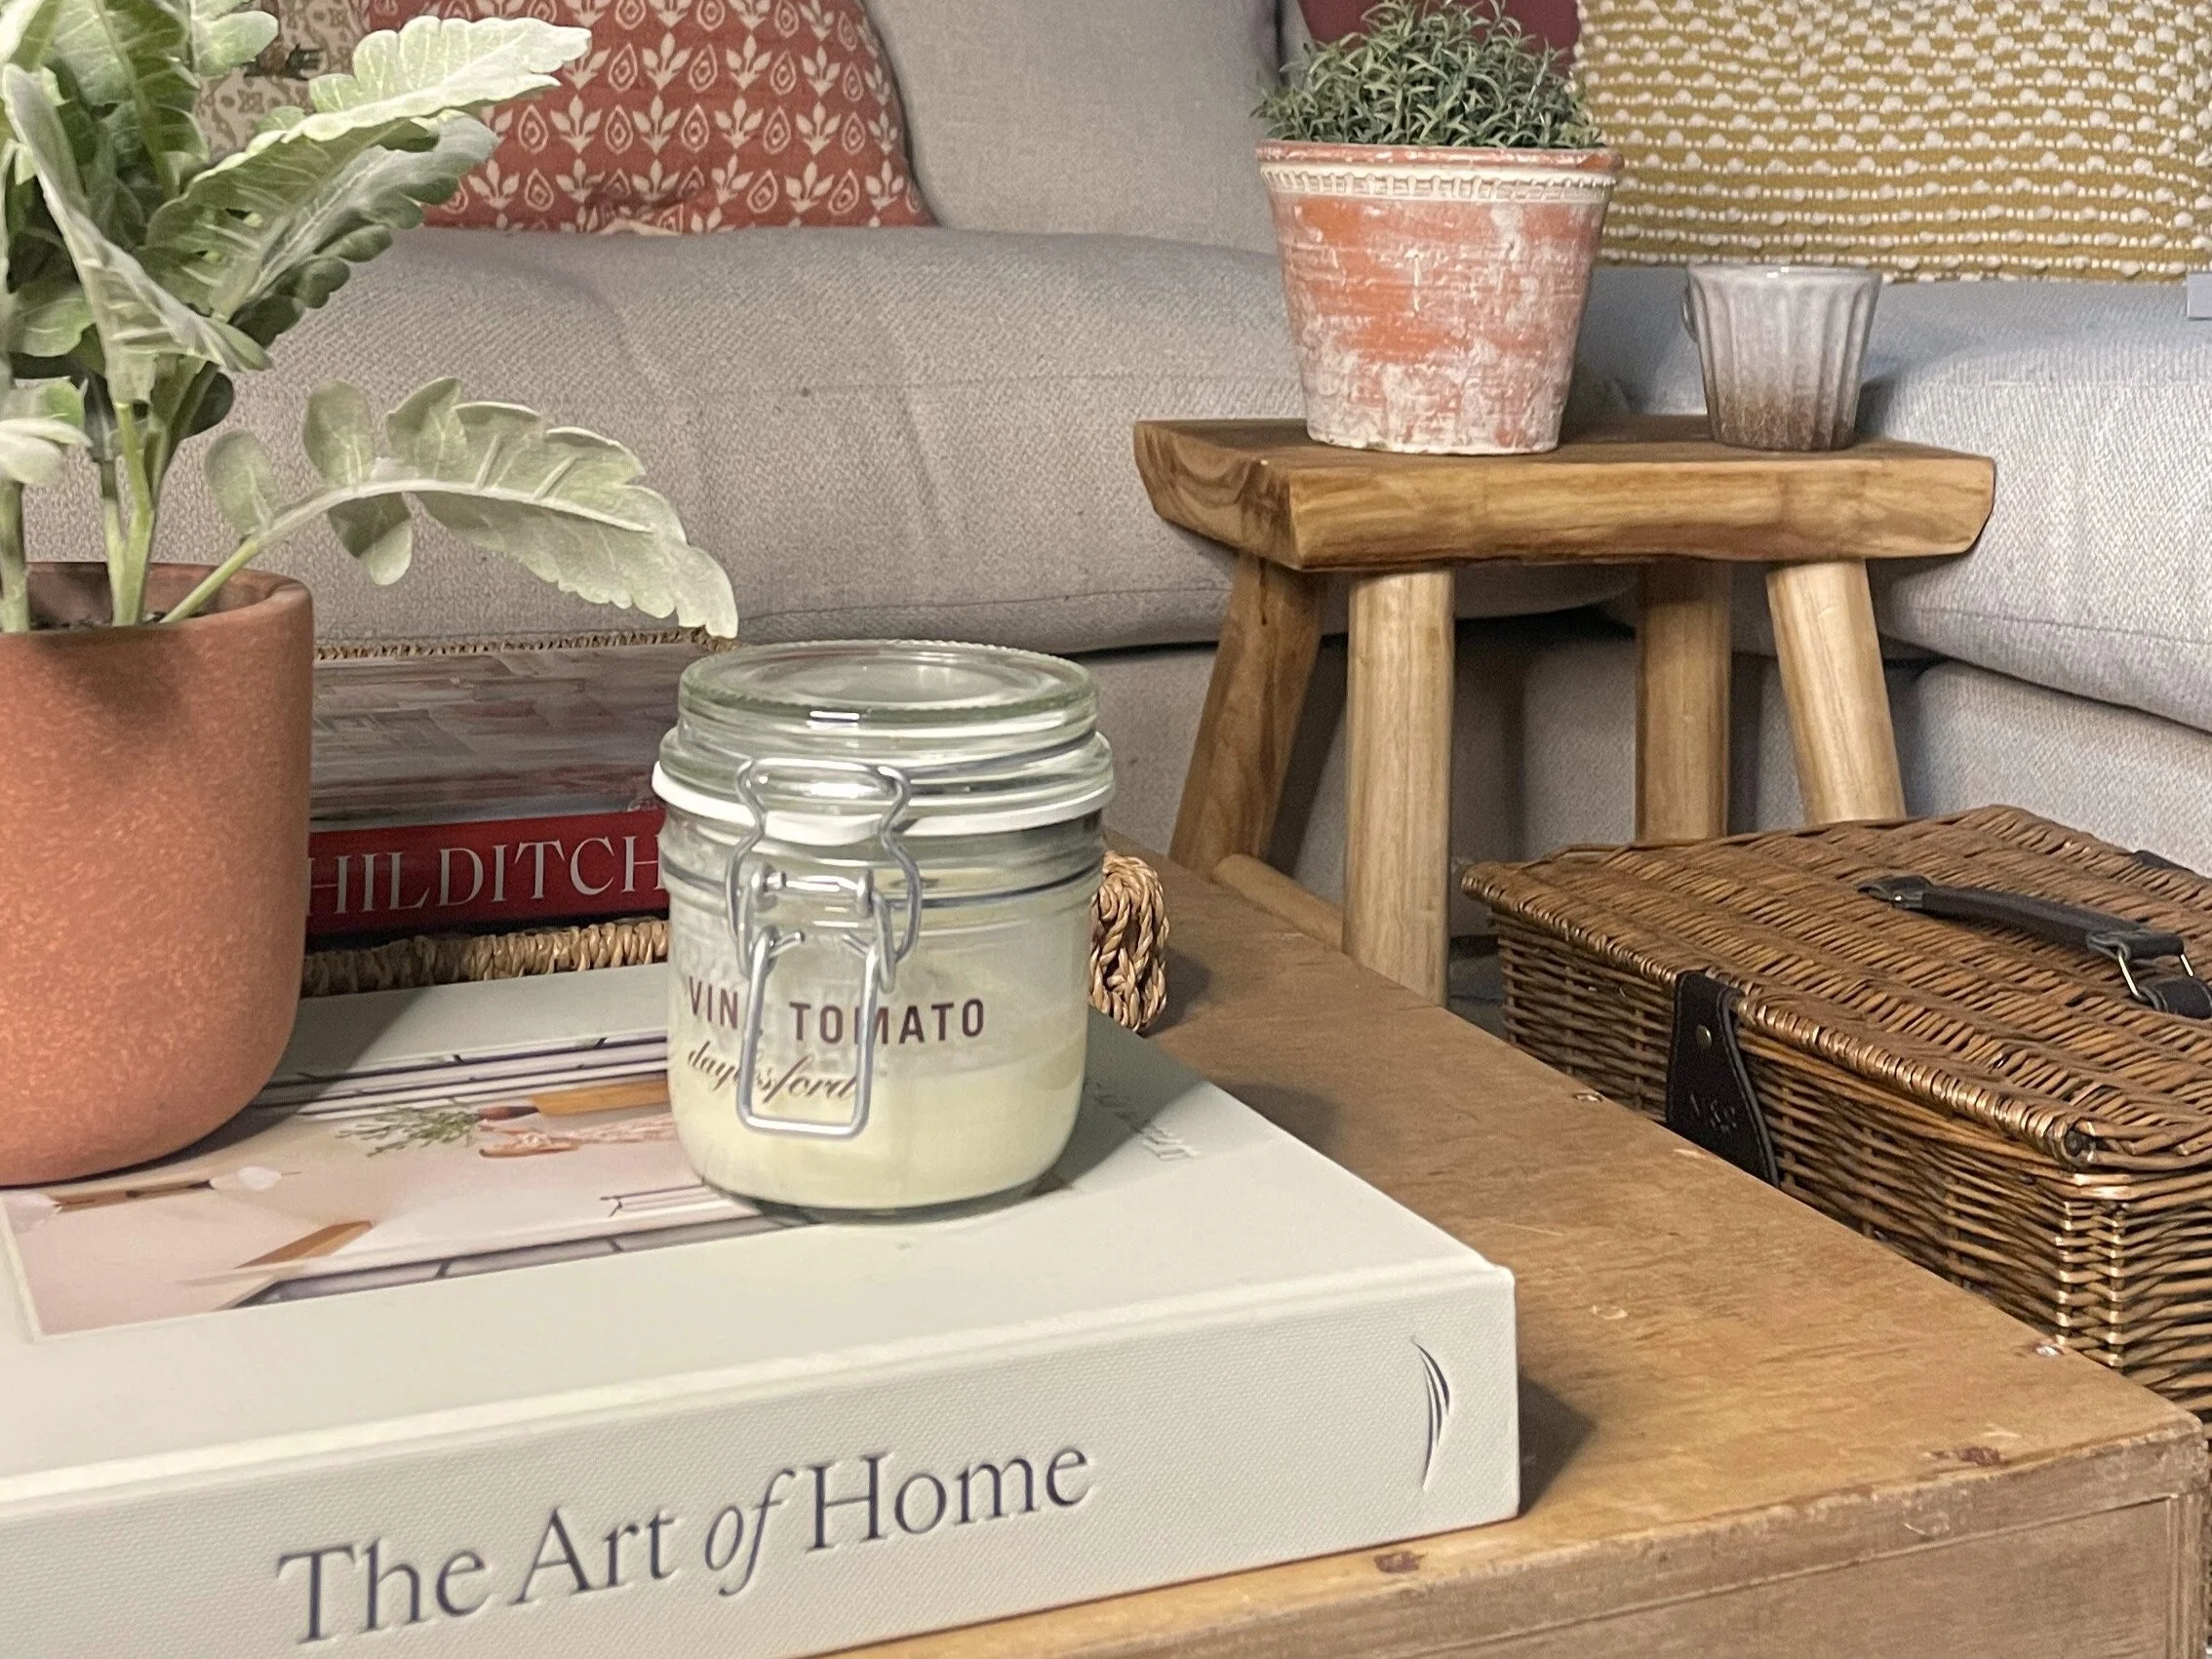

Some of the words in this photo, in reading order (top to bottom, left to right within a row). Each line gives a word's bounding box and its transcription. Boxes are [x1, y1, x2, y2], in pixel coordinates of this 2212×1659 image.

[306, 834, 665, 917] HILDITCH
[688, 975, 763, 1037] VIN
[789, 998, 984, 1045] TOMATO
[276, 1537, 486, 1644] The
[508, 1506, 677, 1606] Art
[704, 1467, 797, 1597] of
[807, 1444, 1092, 1551] Home
